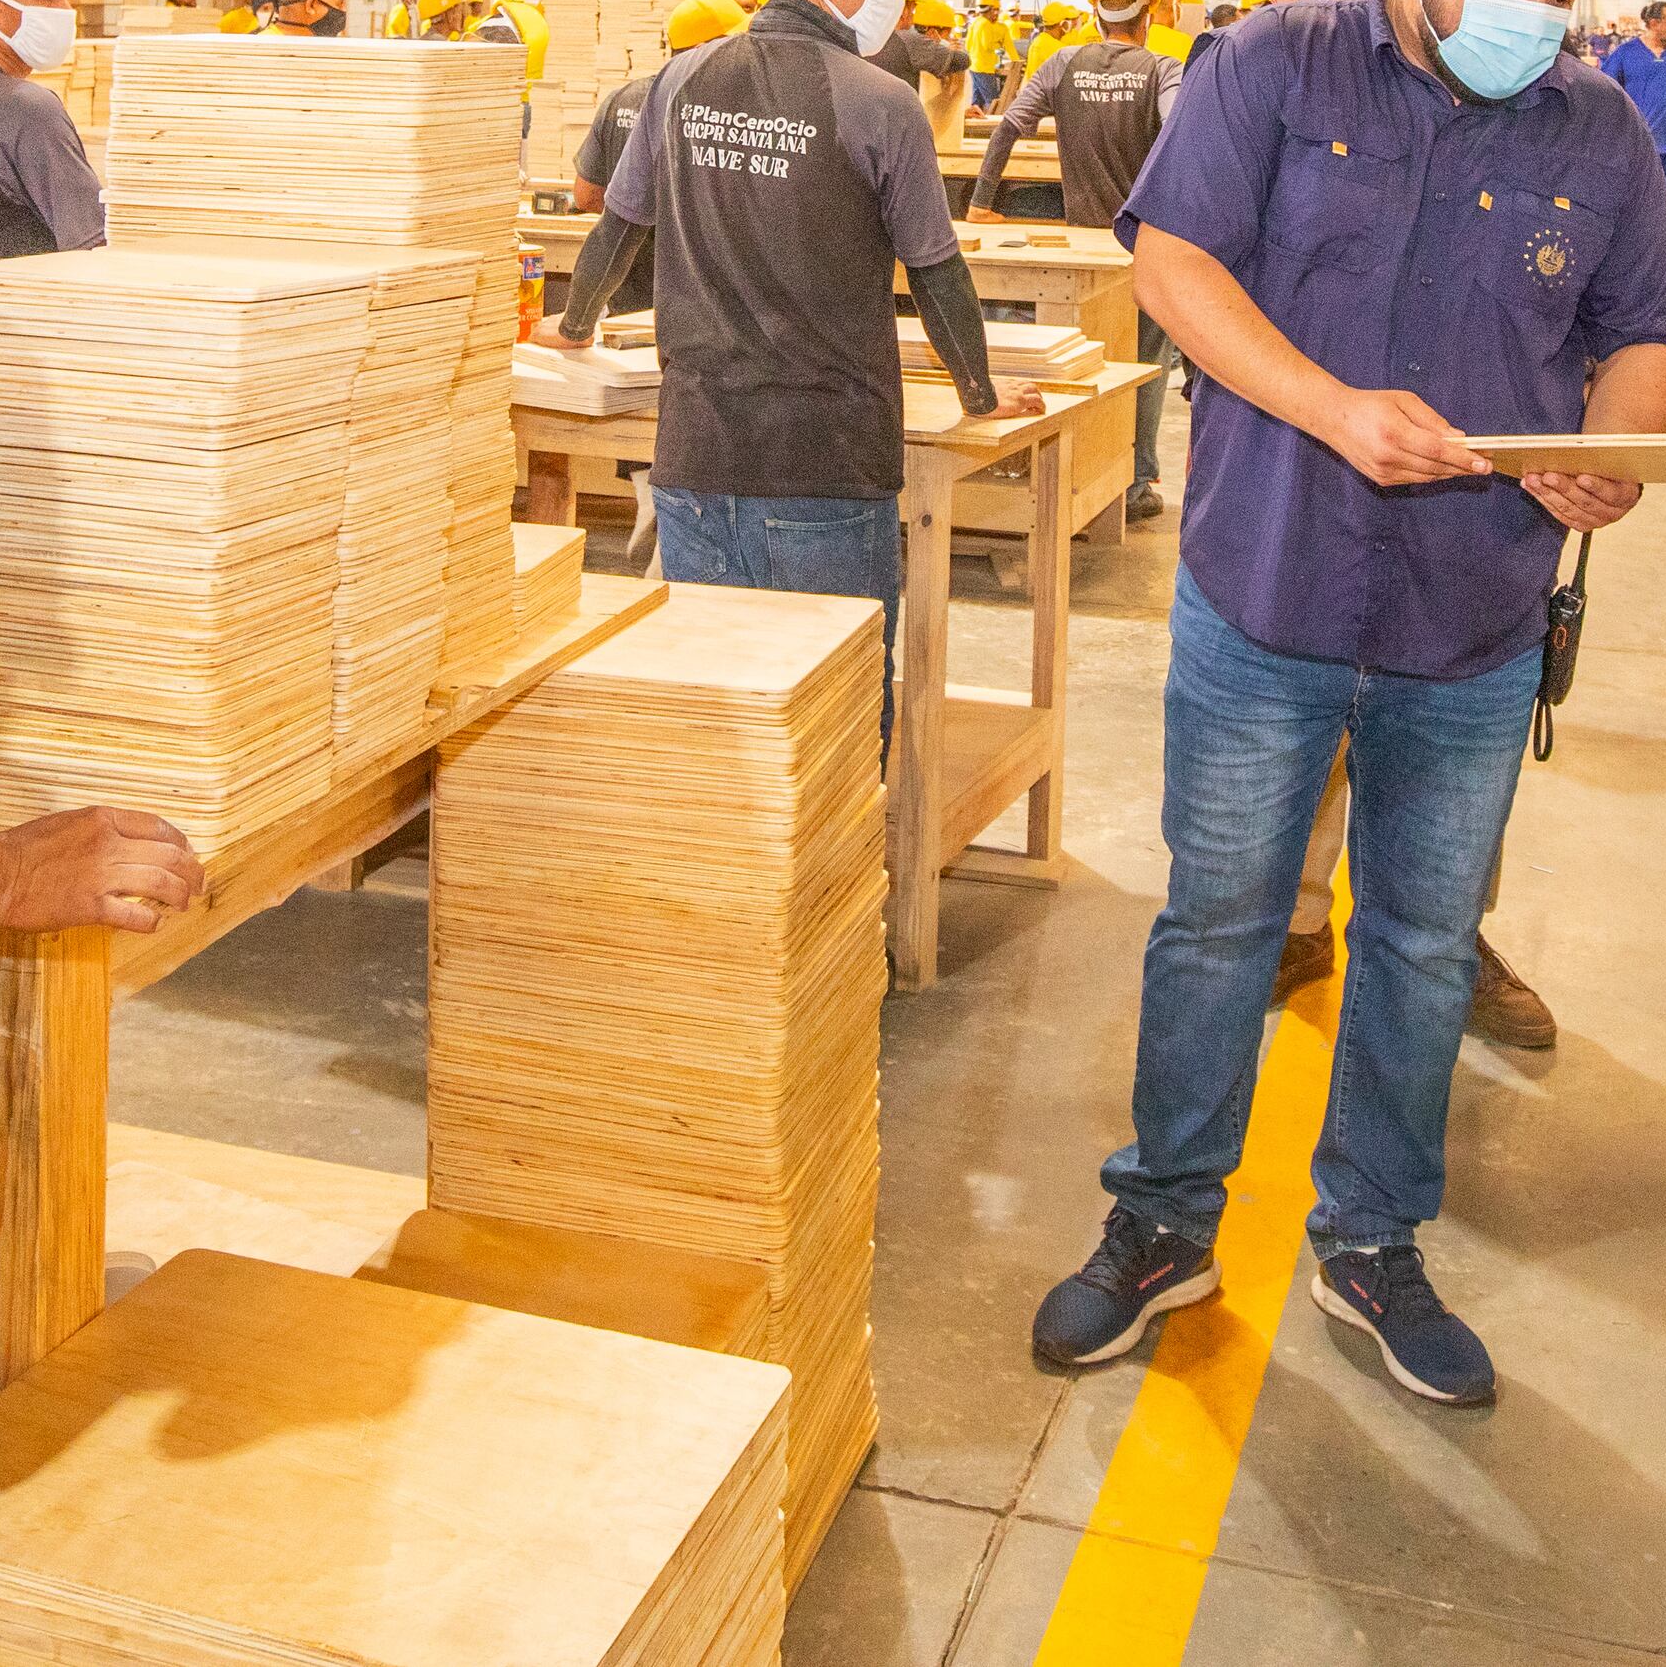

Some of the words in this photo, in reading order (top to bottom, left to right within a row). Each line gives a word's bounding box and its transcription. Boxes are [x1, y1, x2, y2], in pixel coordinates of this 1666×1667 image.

[1073, 70, 1148, 82] #PlanCeroOcio
[1074, 79, 1098, 89] CICPR
[1099, 79, 1124, 90] SANTA
[1125, 79, 1144, 89] ANA
[1080, 90, 1110, 102] NAVE
[1111, 90, 1135, 102] SUR
[681, 103, 817, 138] #PlanCeroOcio
[683, 122, 725, 143] CICPR
[726, 127, 773, 150] SANTA
[776, 135, 807, 155] ANA
[692, 145, 745, 171] NAVE
[748, 154, 790, 179] SUR
